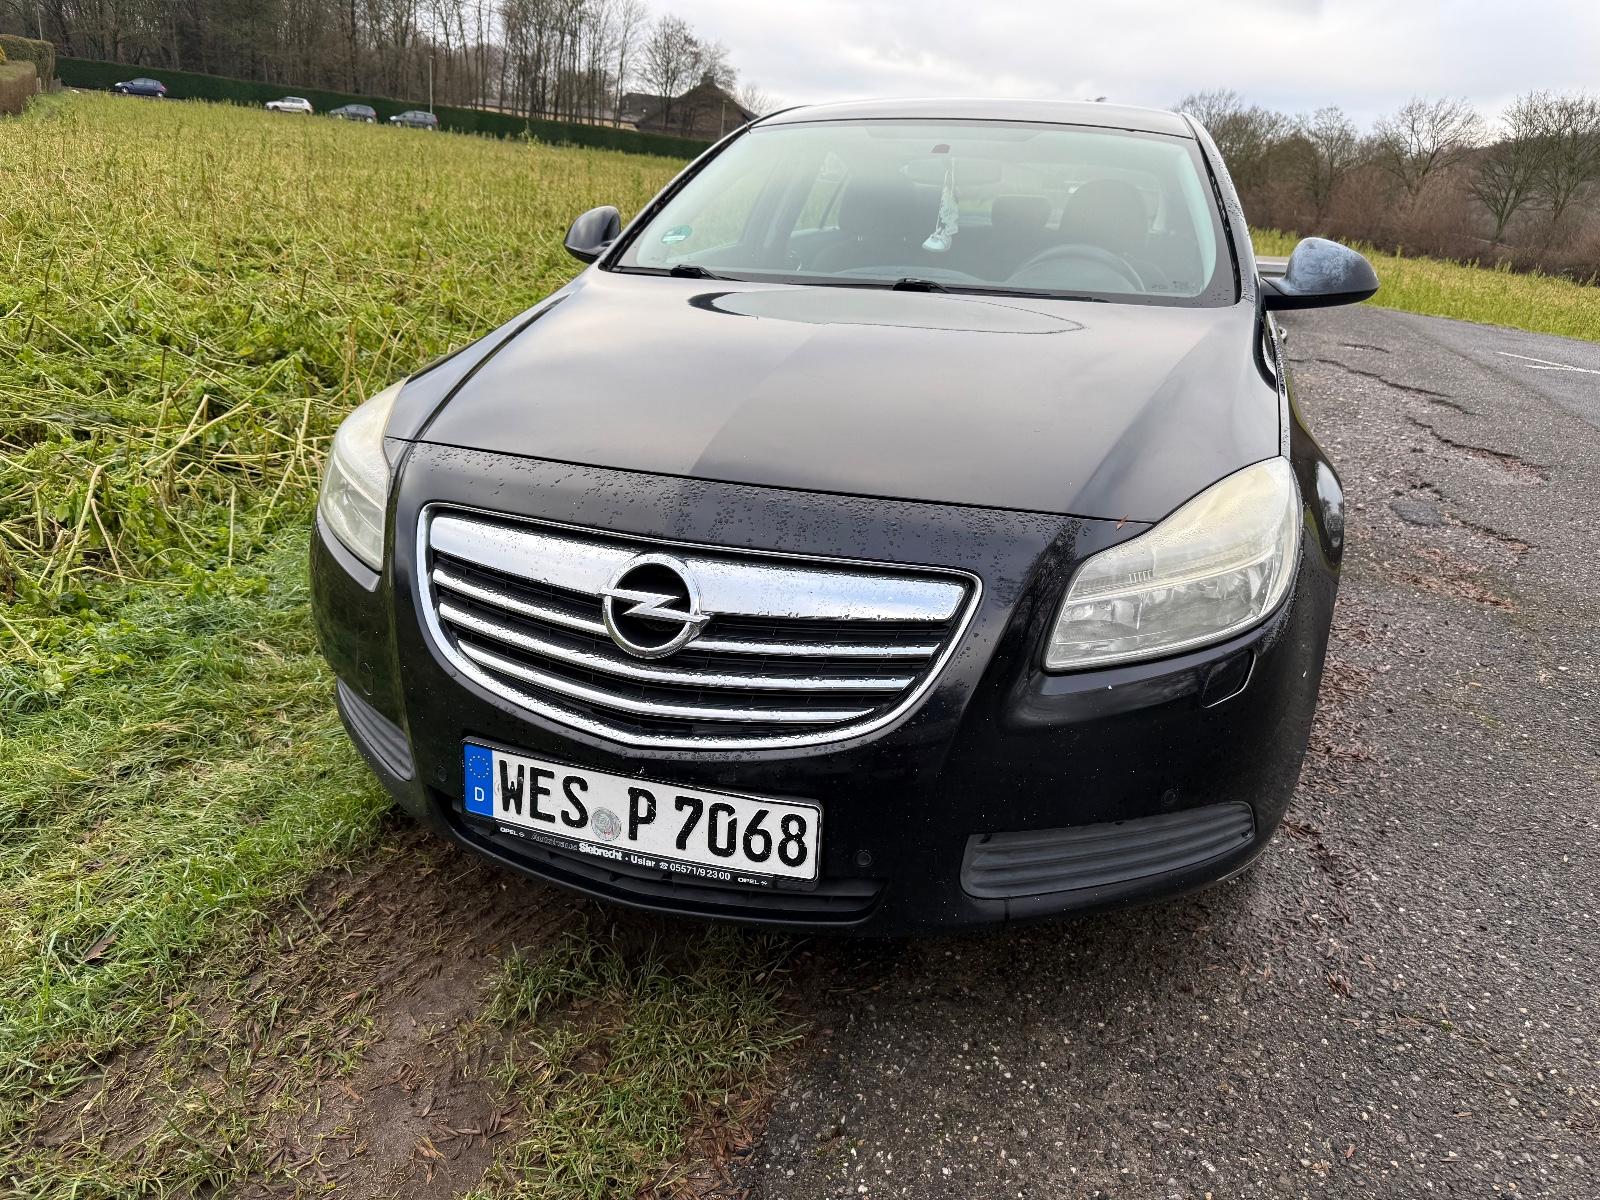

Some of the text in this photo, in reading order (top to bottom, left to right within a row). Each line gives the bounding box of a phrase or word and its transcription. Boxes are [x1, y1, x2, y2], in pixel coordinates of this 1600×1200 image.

[474, 787, 485, 802] D
[498, 759, 808, 867] WES P 7068
